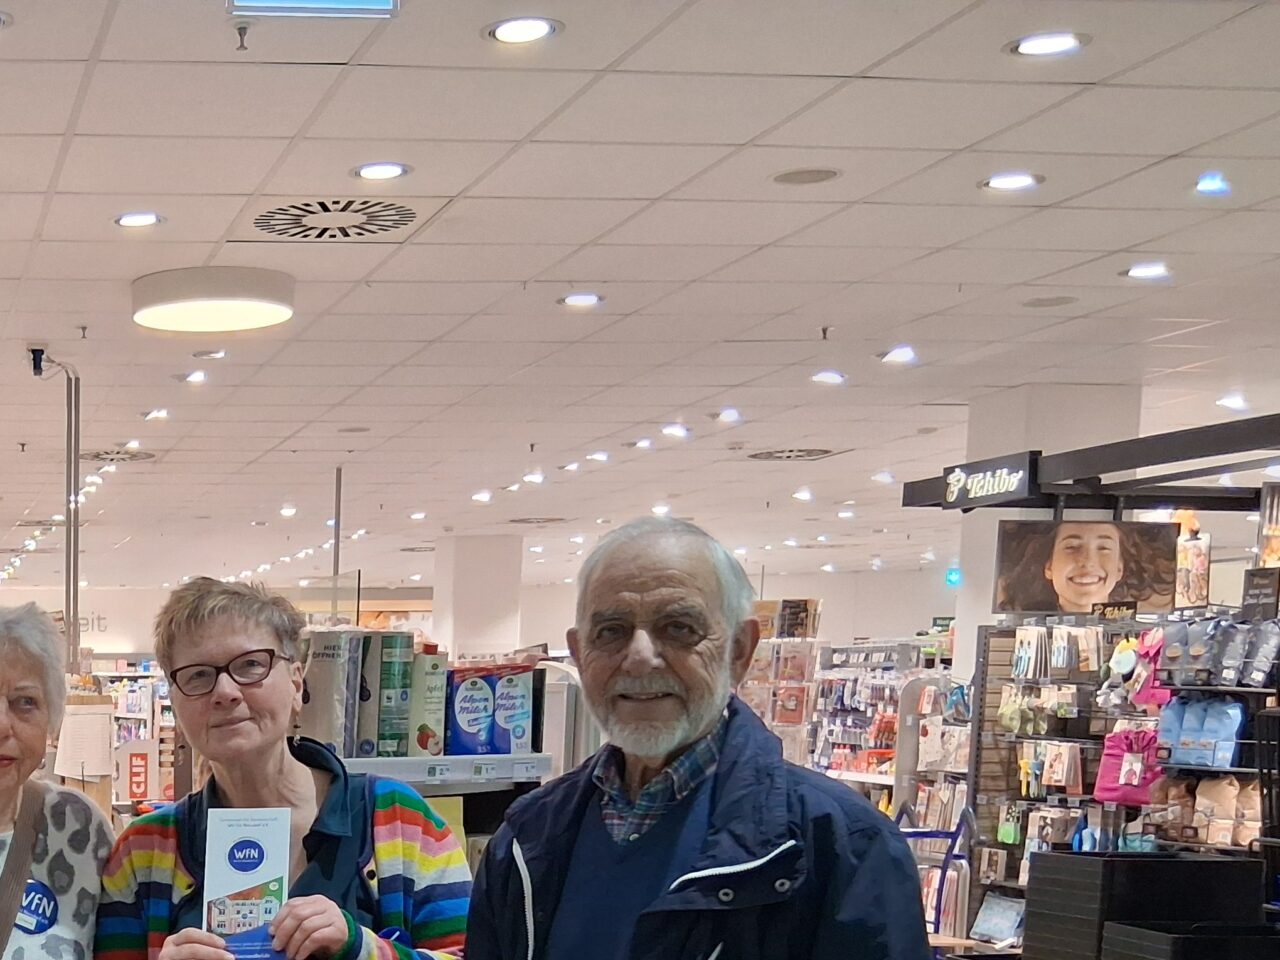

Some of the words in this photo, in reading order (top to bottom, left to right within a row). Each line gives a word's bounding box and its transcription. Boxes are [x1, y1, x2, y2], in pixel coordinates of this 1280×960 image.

[966, 468, 1024, 498] Tchibo
[77, 611, 108, 632] eit
[459, 694, 489, 705] Alpen
[458, 705, 488, 715] Milch
[131, 756, 146, 794] CLIF
[233, 848, 259, 860] WfN
